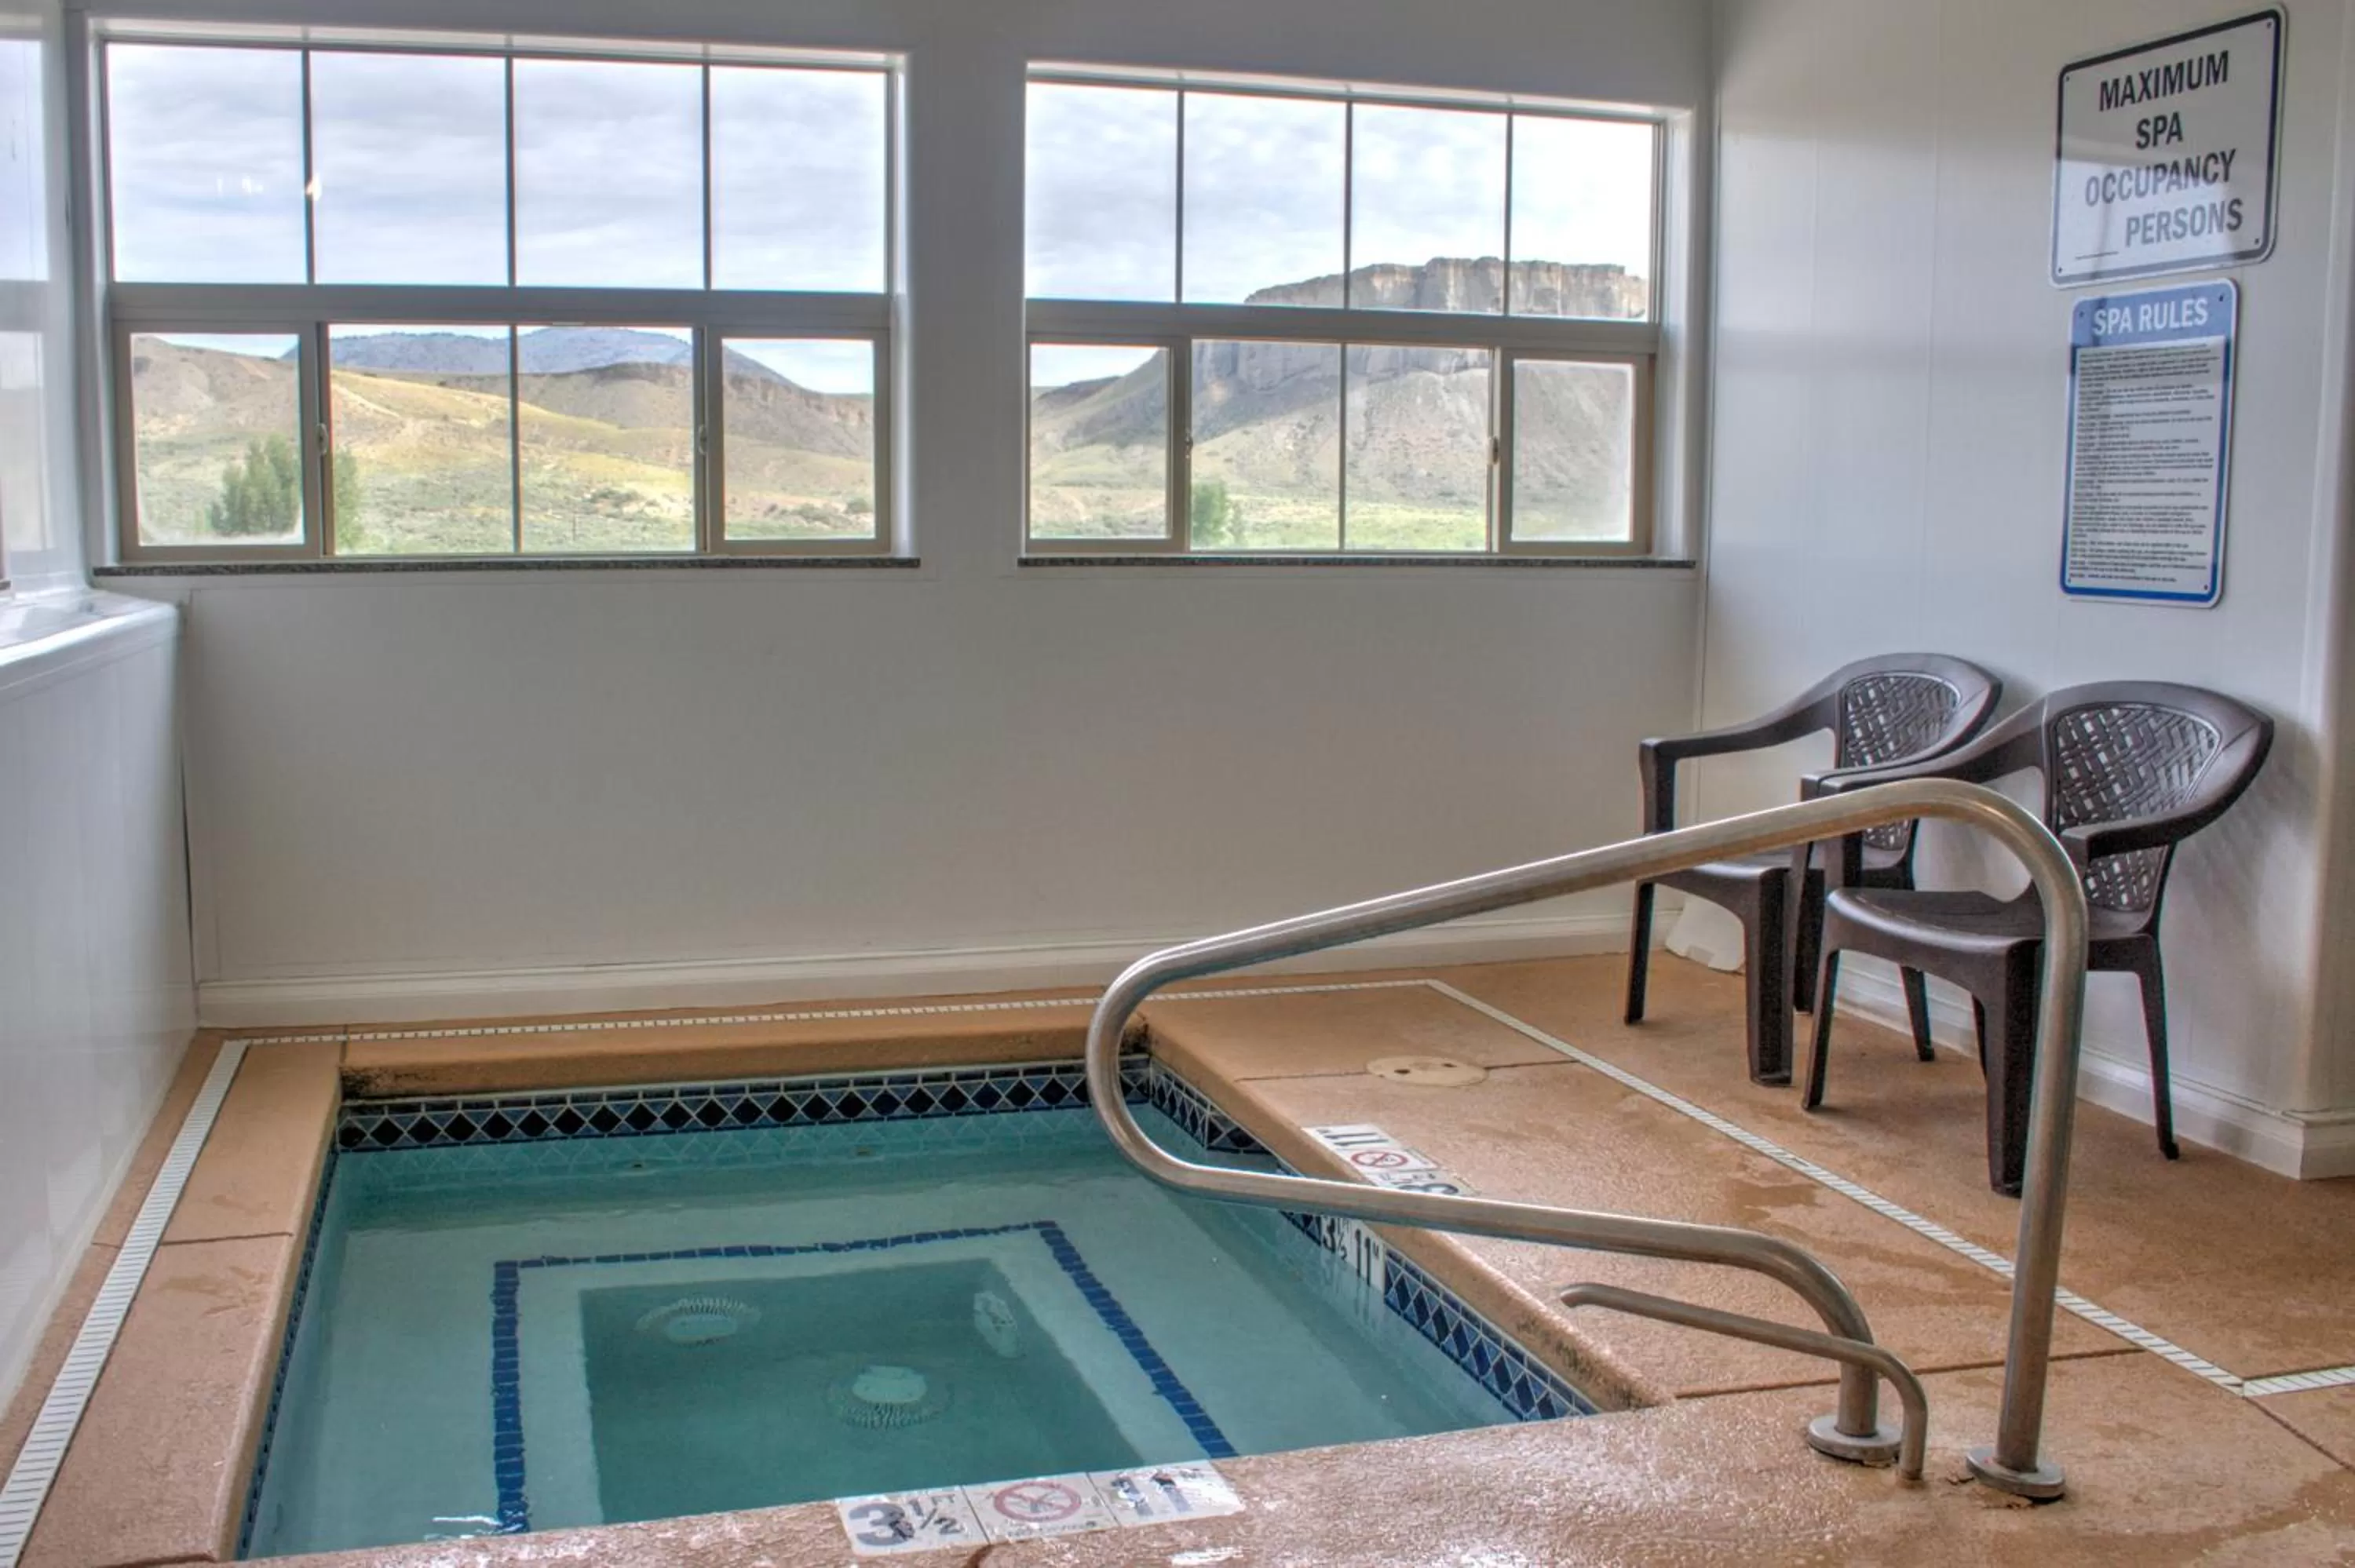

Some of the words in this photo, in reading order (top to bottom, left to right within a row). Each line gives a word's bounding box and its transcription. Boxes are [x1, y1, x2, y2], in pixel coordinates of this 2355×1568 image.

[2099, 50, 2229, 111] MAXIMUM
[2136, 111, 2183, 150] SPA
[2085, 148, 2236, 207] OCCUPANCY
[2125, 198, 2244, 248] PERSONS
[2093, 308, 2133, 336] SPA
[2138, 297, 2209, 332] RULES
